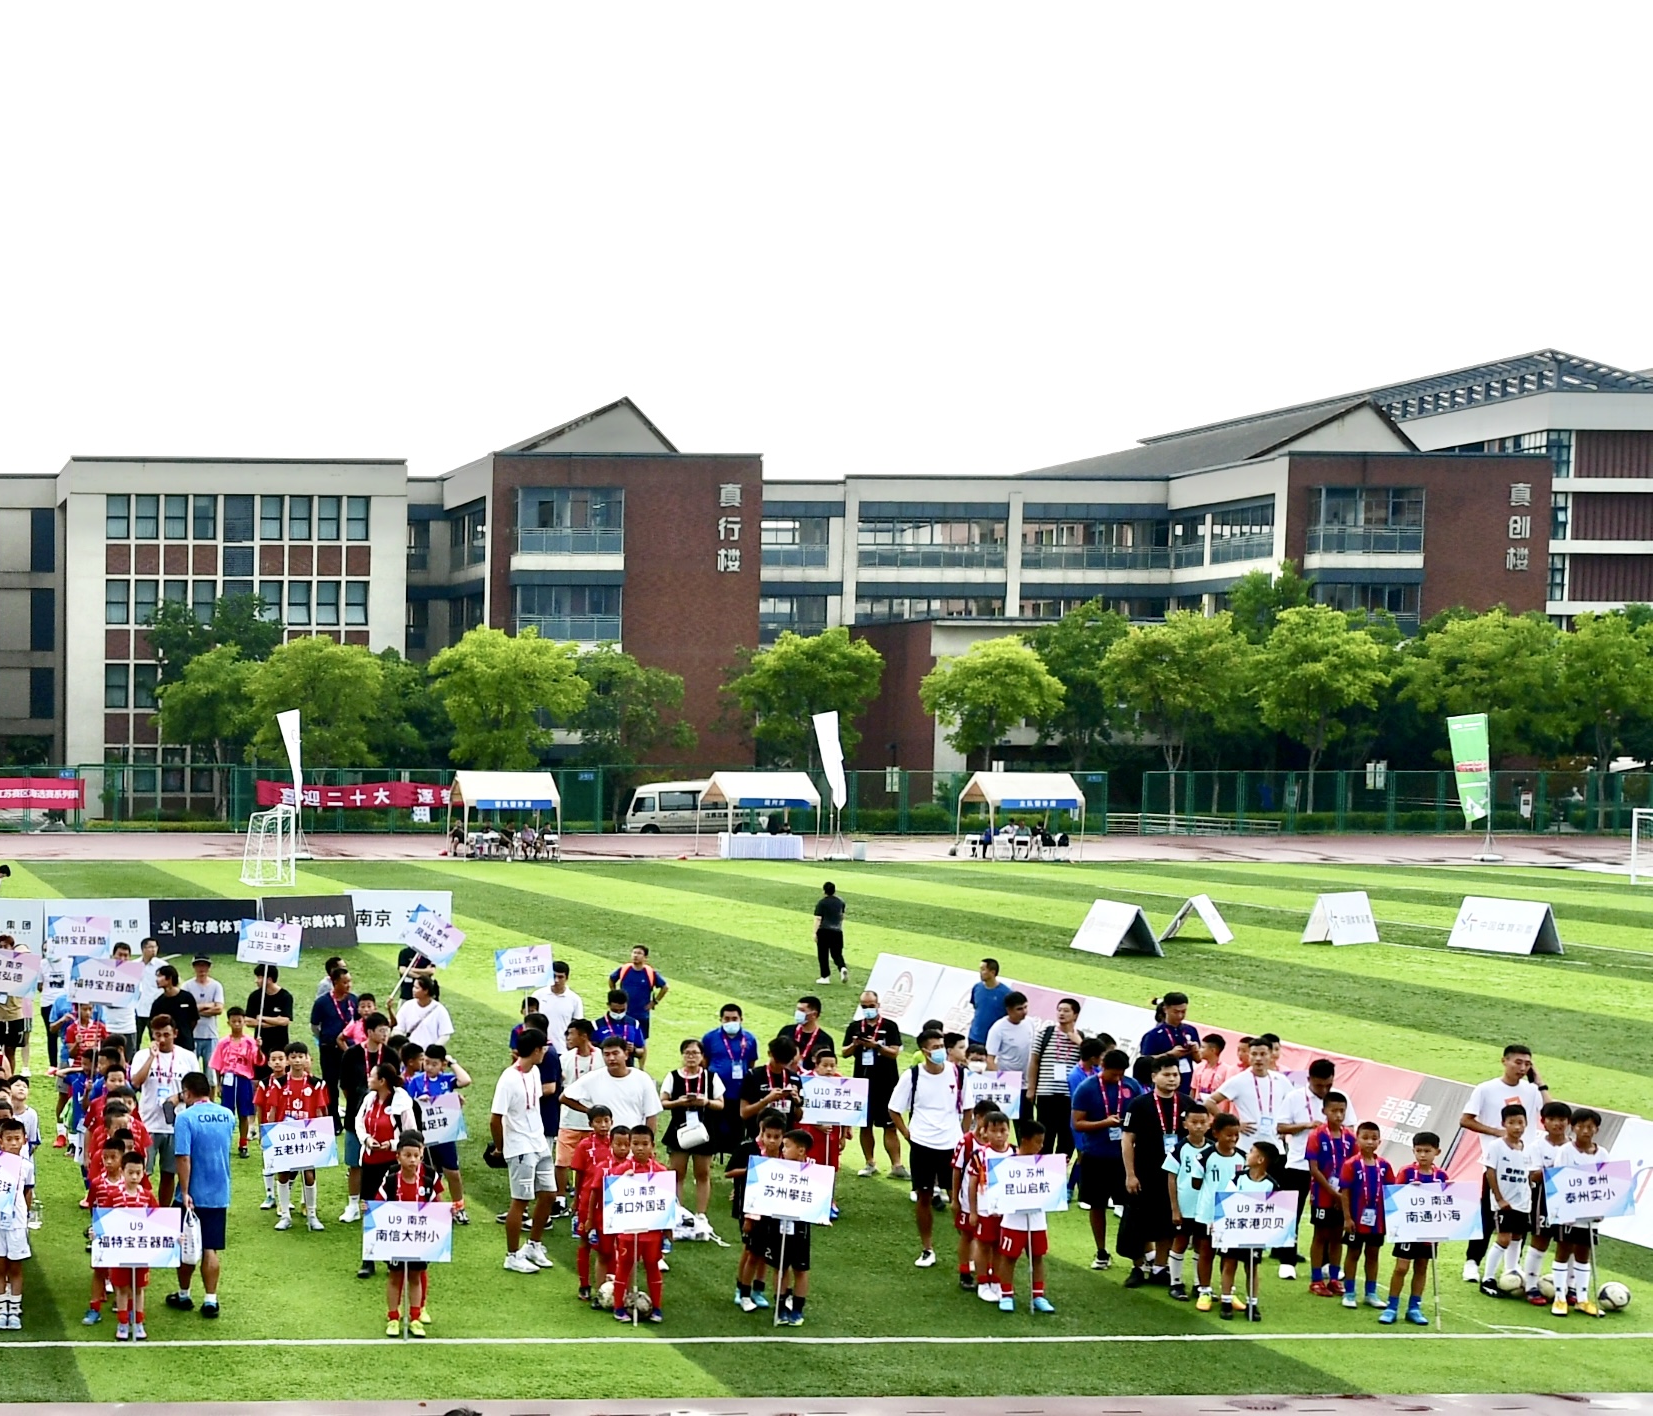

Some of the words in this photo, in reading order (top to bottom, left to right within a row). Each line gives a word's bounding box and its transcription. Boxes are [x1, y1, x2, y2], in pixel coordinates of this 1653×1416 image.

[717, 483, 742, 573] 真行楼
[1506, 483, 1532, 571] 真创楼
[280, 788, 391, 806] 喜迎二十大
[114, 920, 138, 929] 集团
[289, 914, 346, 928] 卡尔美体育
[355, 910, 392, 927] 南京
[178, 919, 242, 934] 卡尔美体育
[422, 919, 436, 931] U11
[52, 936, 106, 945] 福特宝吾器酷
[6, 961, 23, 969] 南京
[99, 969, 115, 977] U10
[74, 979, 135, 993] 福特宝吾器酷
[834, 1088, 851, 1096] 苏州
[198, 1114, 230, 1123] COACH
[279, 1133, 295, 1142] U10
[300, 1130, 317, 1140] 南京
[273, 1142, 326, 1157] 五老村小学
[1186, 1160, 1192, 1172] 5
[771, 1172, 784, 1181] U9
[789, 1174, 809, 1185] 苏州
[1009, 1169, 1021, 1178] U9
[1026, 1168, 1045, 1178] 苏州
[1211, 1169, 1220, 1182] 11
[1569, 1179, 1583, 1187] U9
[1588, 1175, 1608, 1185] 泰州
[624, 1188, 636, 1196] U9
[639, 1186, 656, 1196] 南京
[763, 1185, 813, 1203] 苏州攀喆
[1005, 1182, 1050, 1195] 昆山启航
[1410, 1197, 1425, 1206] U9
[1431, 1195, 1454, 1206] 南通
[1565, 1189, 1615, 1203] 泰州实小
[614, 1200, 666, 1214] 浦口外国语
[1237, 1205, 1249, 1213] U9
[1255, 1204, 1274, 1213] 苏州
[959, 1213, 966, 1225] 3
[1316, 1208, 1325, 1219] 18
[1406, 1210, 1461, 1223] 南通小海
[388, 1215, 402, 1225] U9
[407, 1215, 428, 1225] 南京
[1225, 1218, 1284, 1229] 张家港贝贝
[130, 1222, 143, 1231] U9
[376, 1229, 439, 1243] 南信大附小
[98, 1236, 175, 1249] 福特宝吾器酷
[1002, 1236, 1012, 1251] 11
